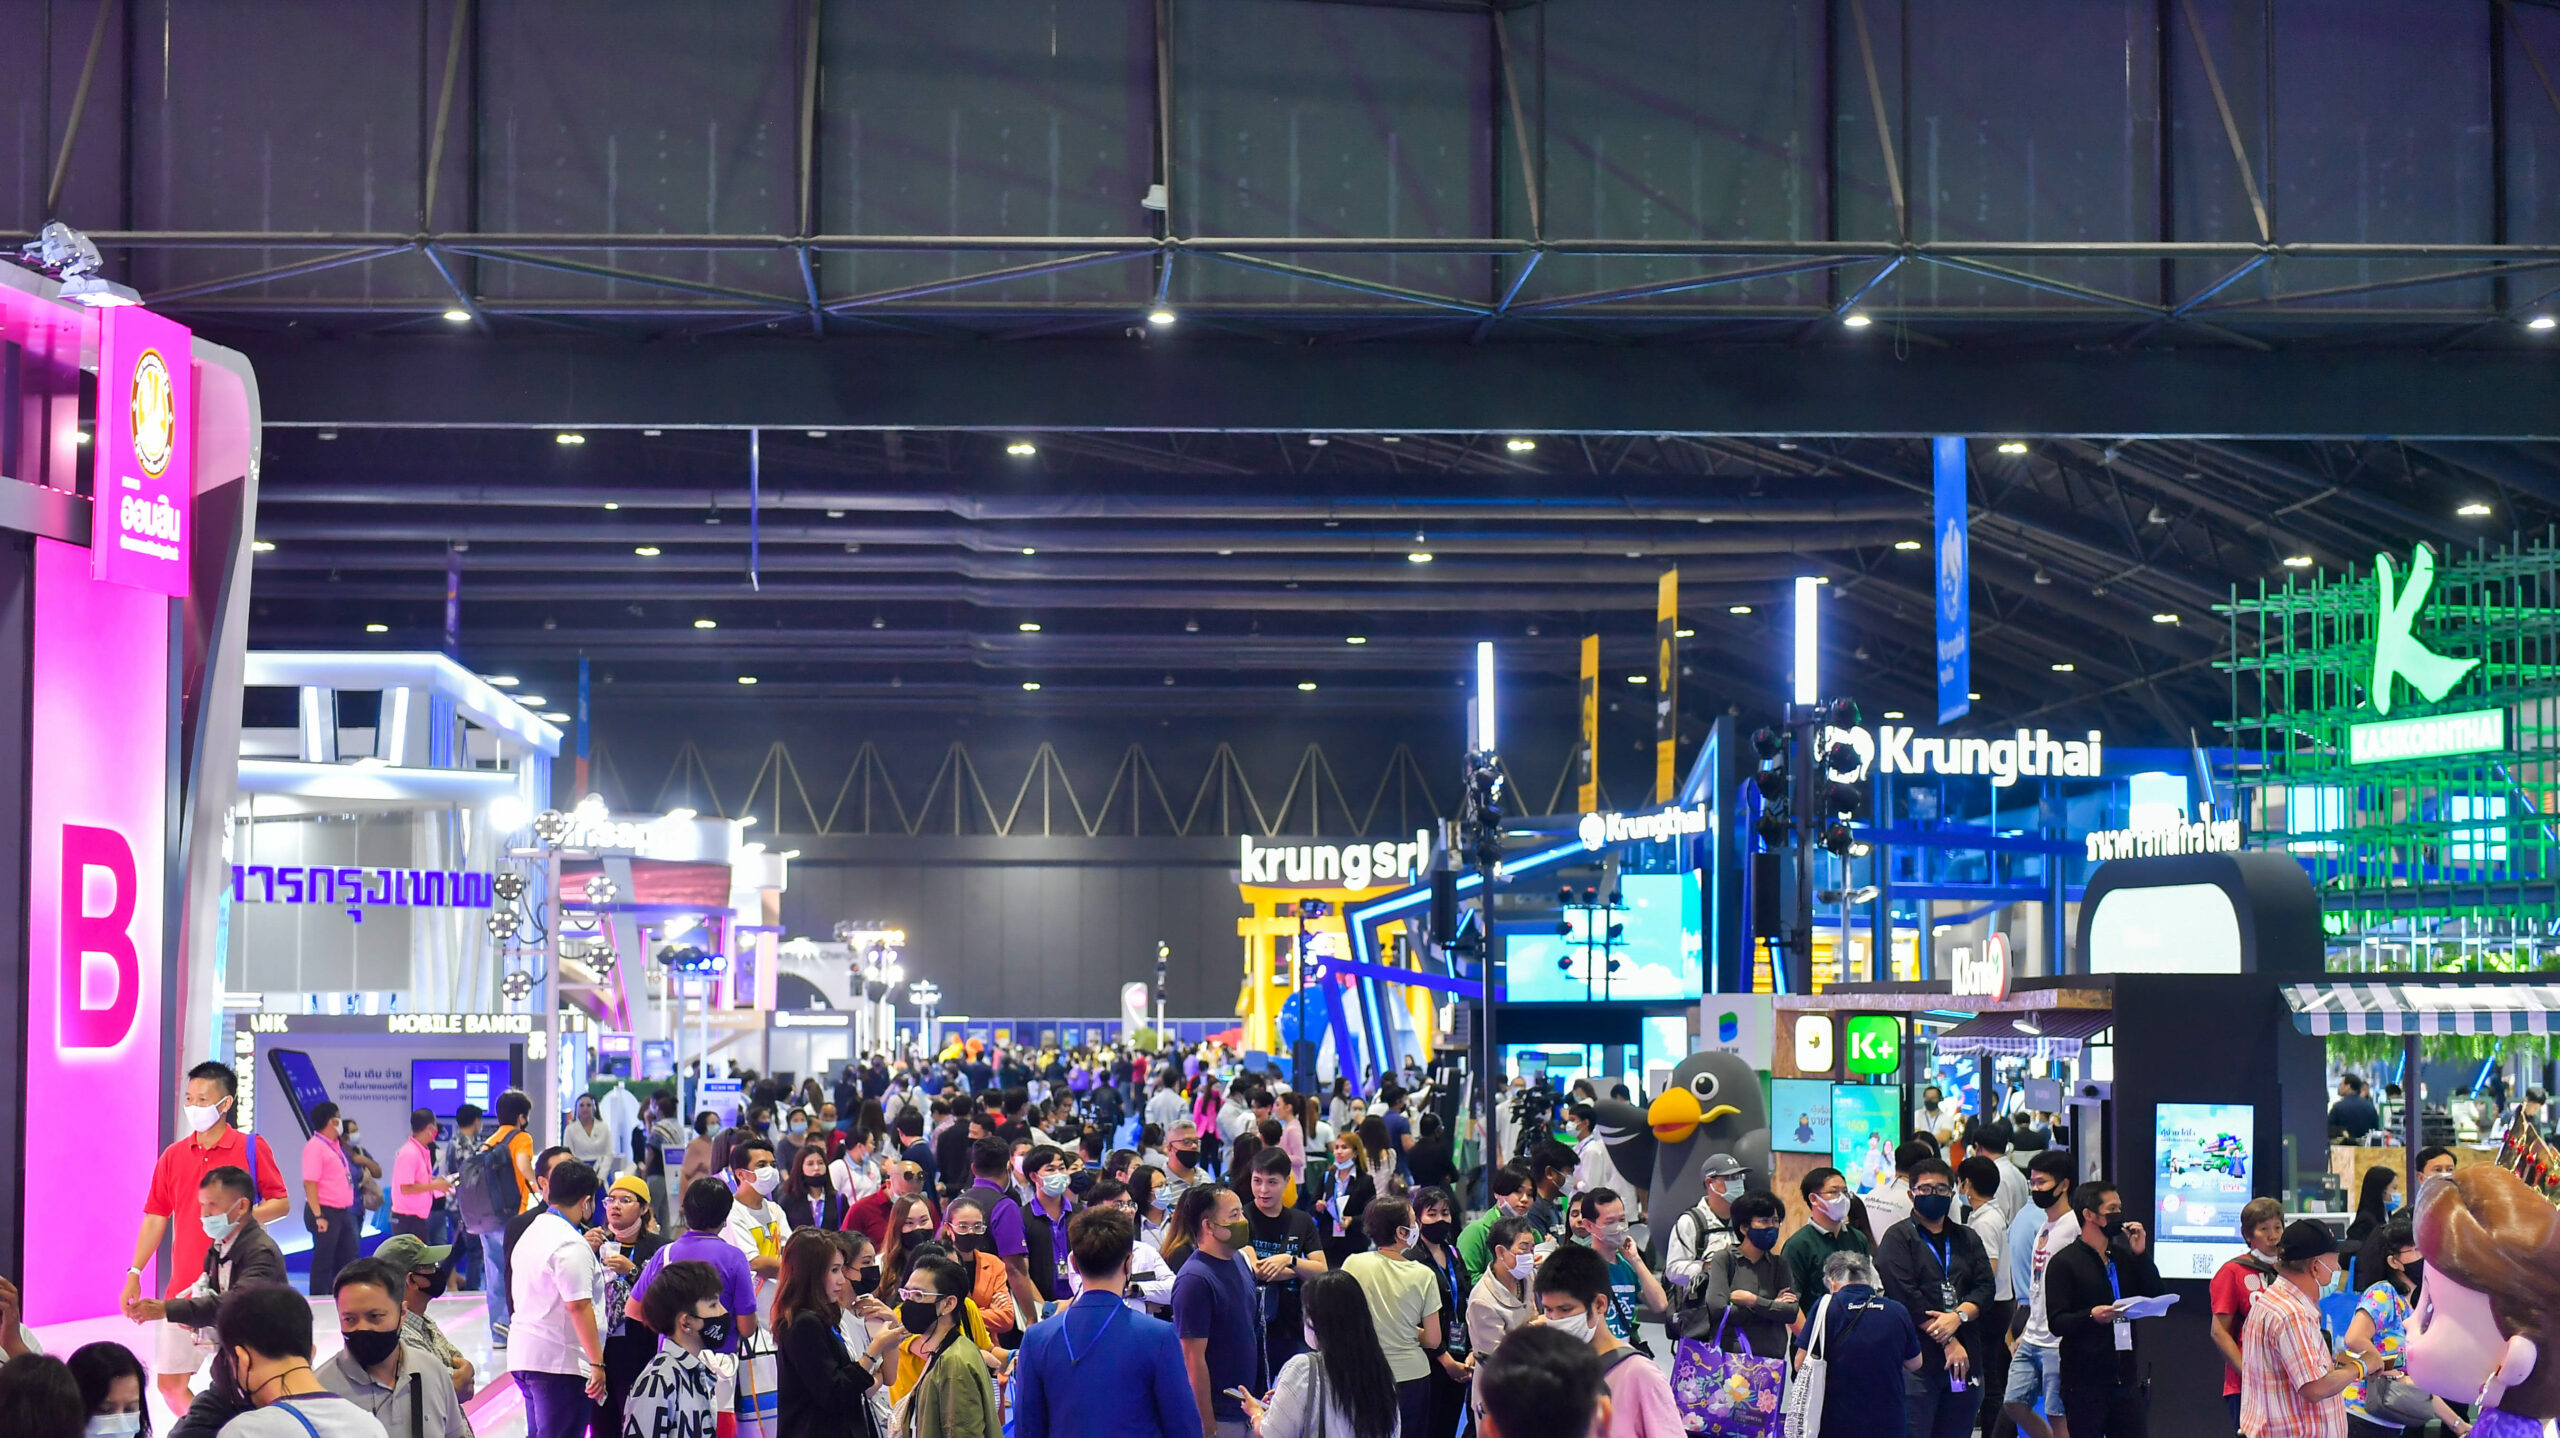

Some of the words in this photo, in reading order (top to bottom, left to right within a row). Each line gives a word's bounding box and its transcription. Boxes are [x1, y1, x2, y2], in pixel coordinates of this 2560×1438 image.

[2353, 714, 2502, 760] KASIKORNTHAI
[1879, 725, 2102, 788] Krungthai
[1605, 802, 1706, 843] Krungthai
[388, 1015, 462, 1033] MOBILE
[1851, 1032, 1894, 1059] K+
[703, 1324, 724, 1341] The
